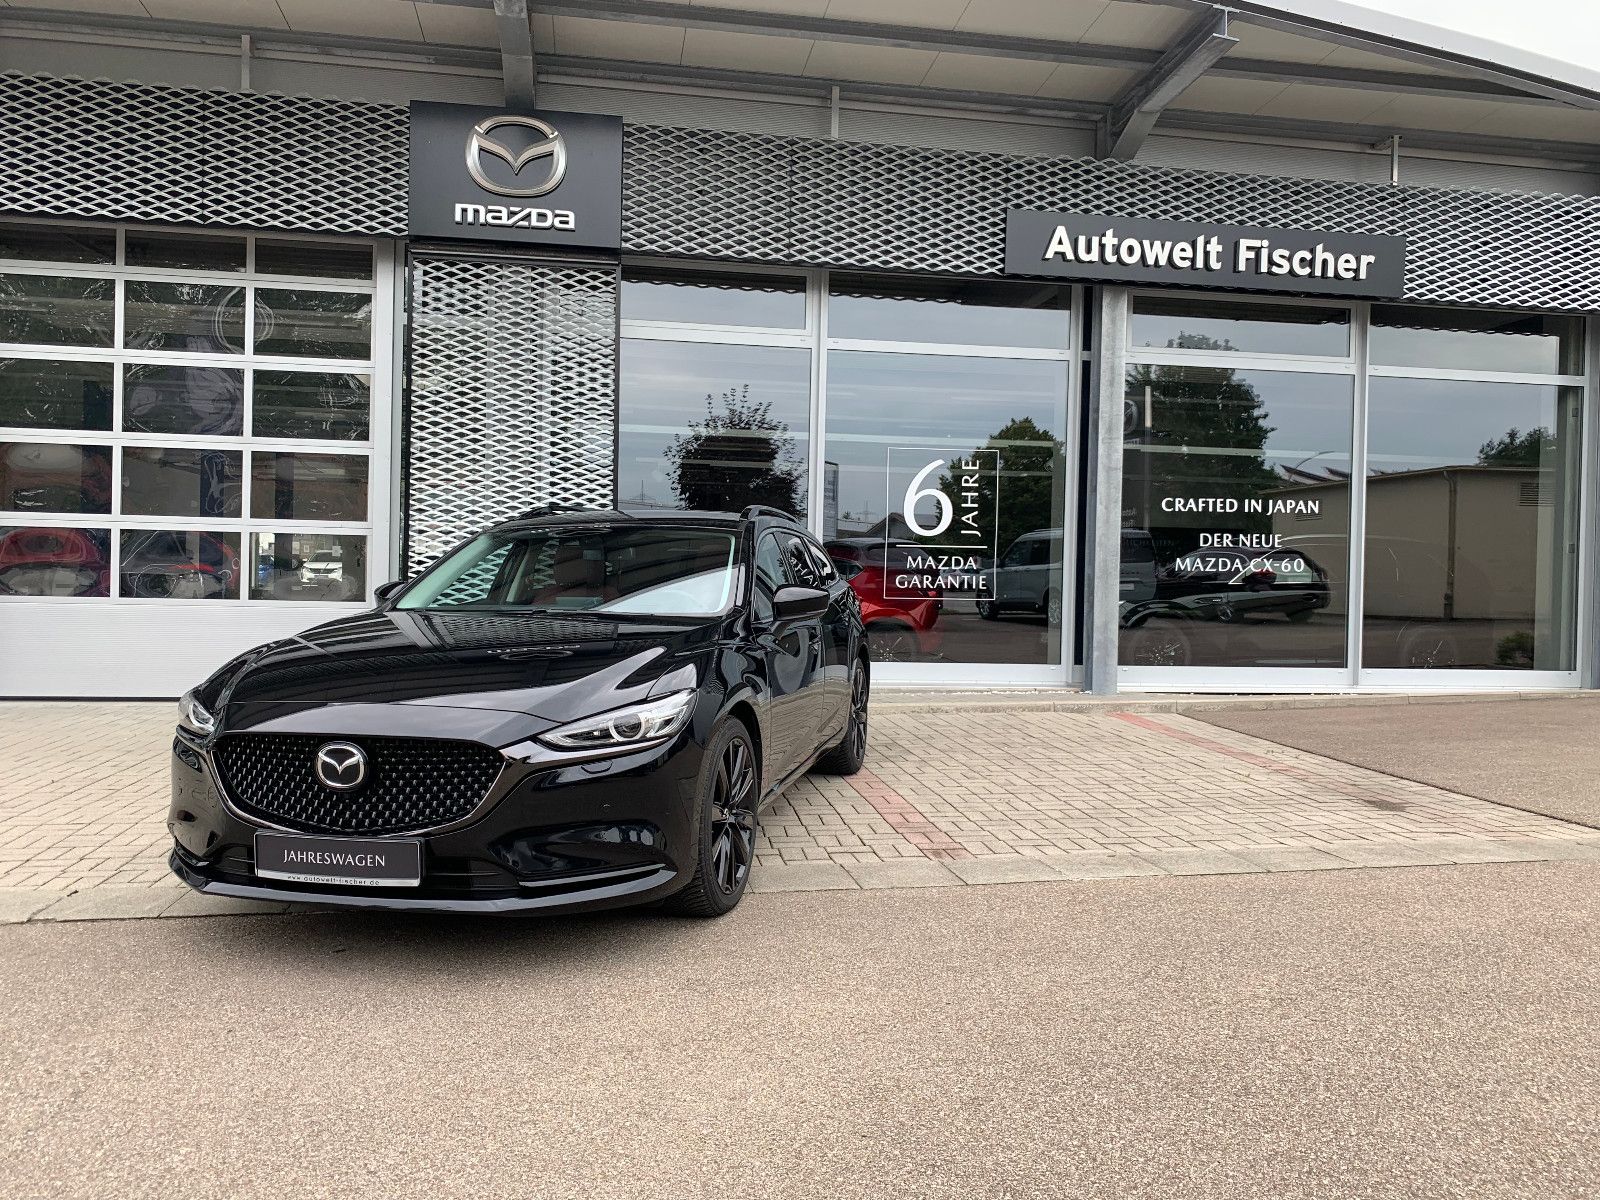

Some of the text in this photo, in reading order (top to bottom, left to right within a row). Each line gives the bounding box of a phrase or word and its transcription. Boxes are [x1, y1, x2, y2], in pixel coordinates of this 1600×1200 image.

[455, 203, 576, 231] mazda
[1043, 225, 1376, 280] Autowelt Fischer
[903, 458, 953, 537] 6
[960, 459, 982, 538] JAHRE
[1161, 497, 1320, 516] CRAFTED IN JAPAN
[1200, 533, 1282, 548] DER NEUE
[906, 555, 977, 570] MAZDA
[1175, 557, 1305, 573] MAZDA CX-60
[895, 574, 988, 590] GARANTIE
[283, 849, 386, 867] JAHRESWAGEN
